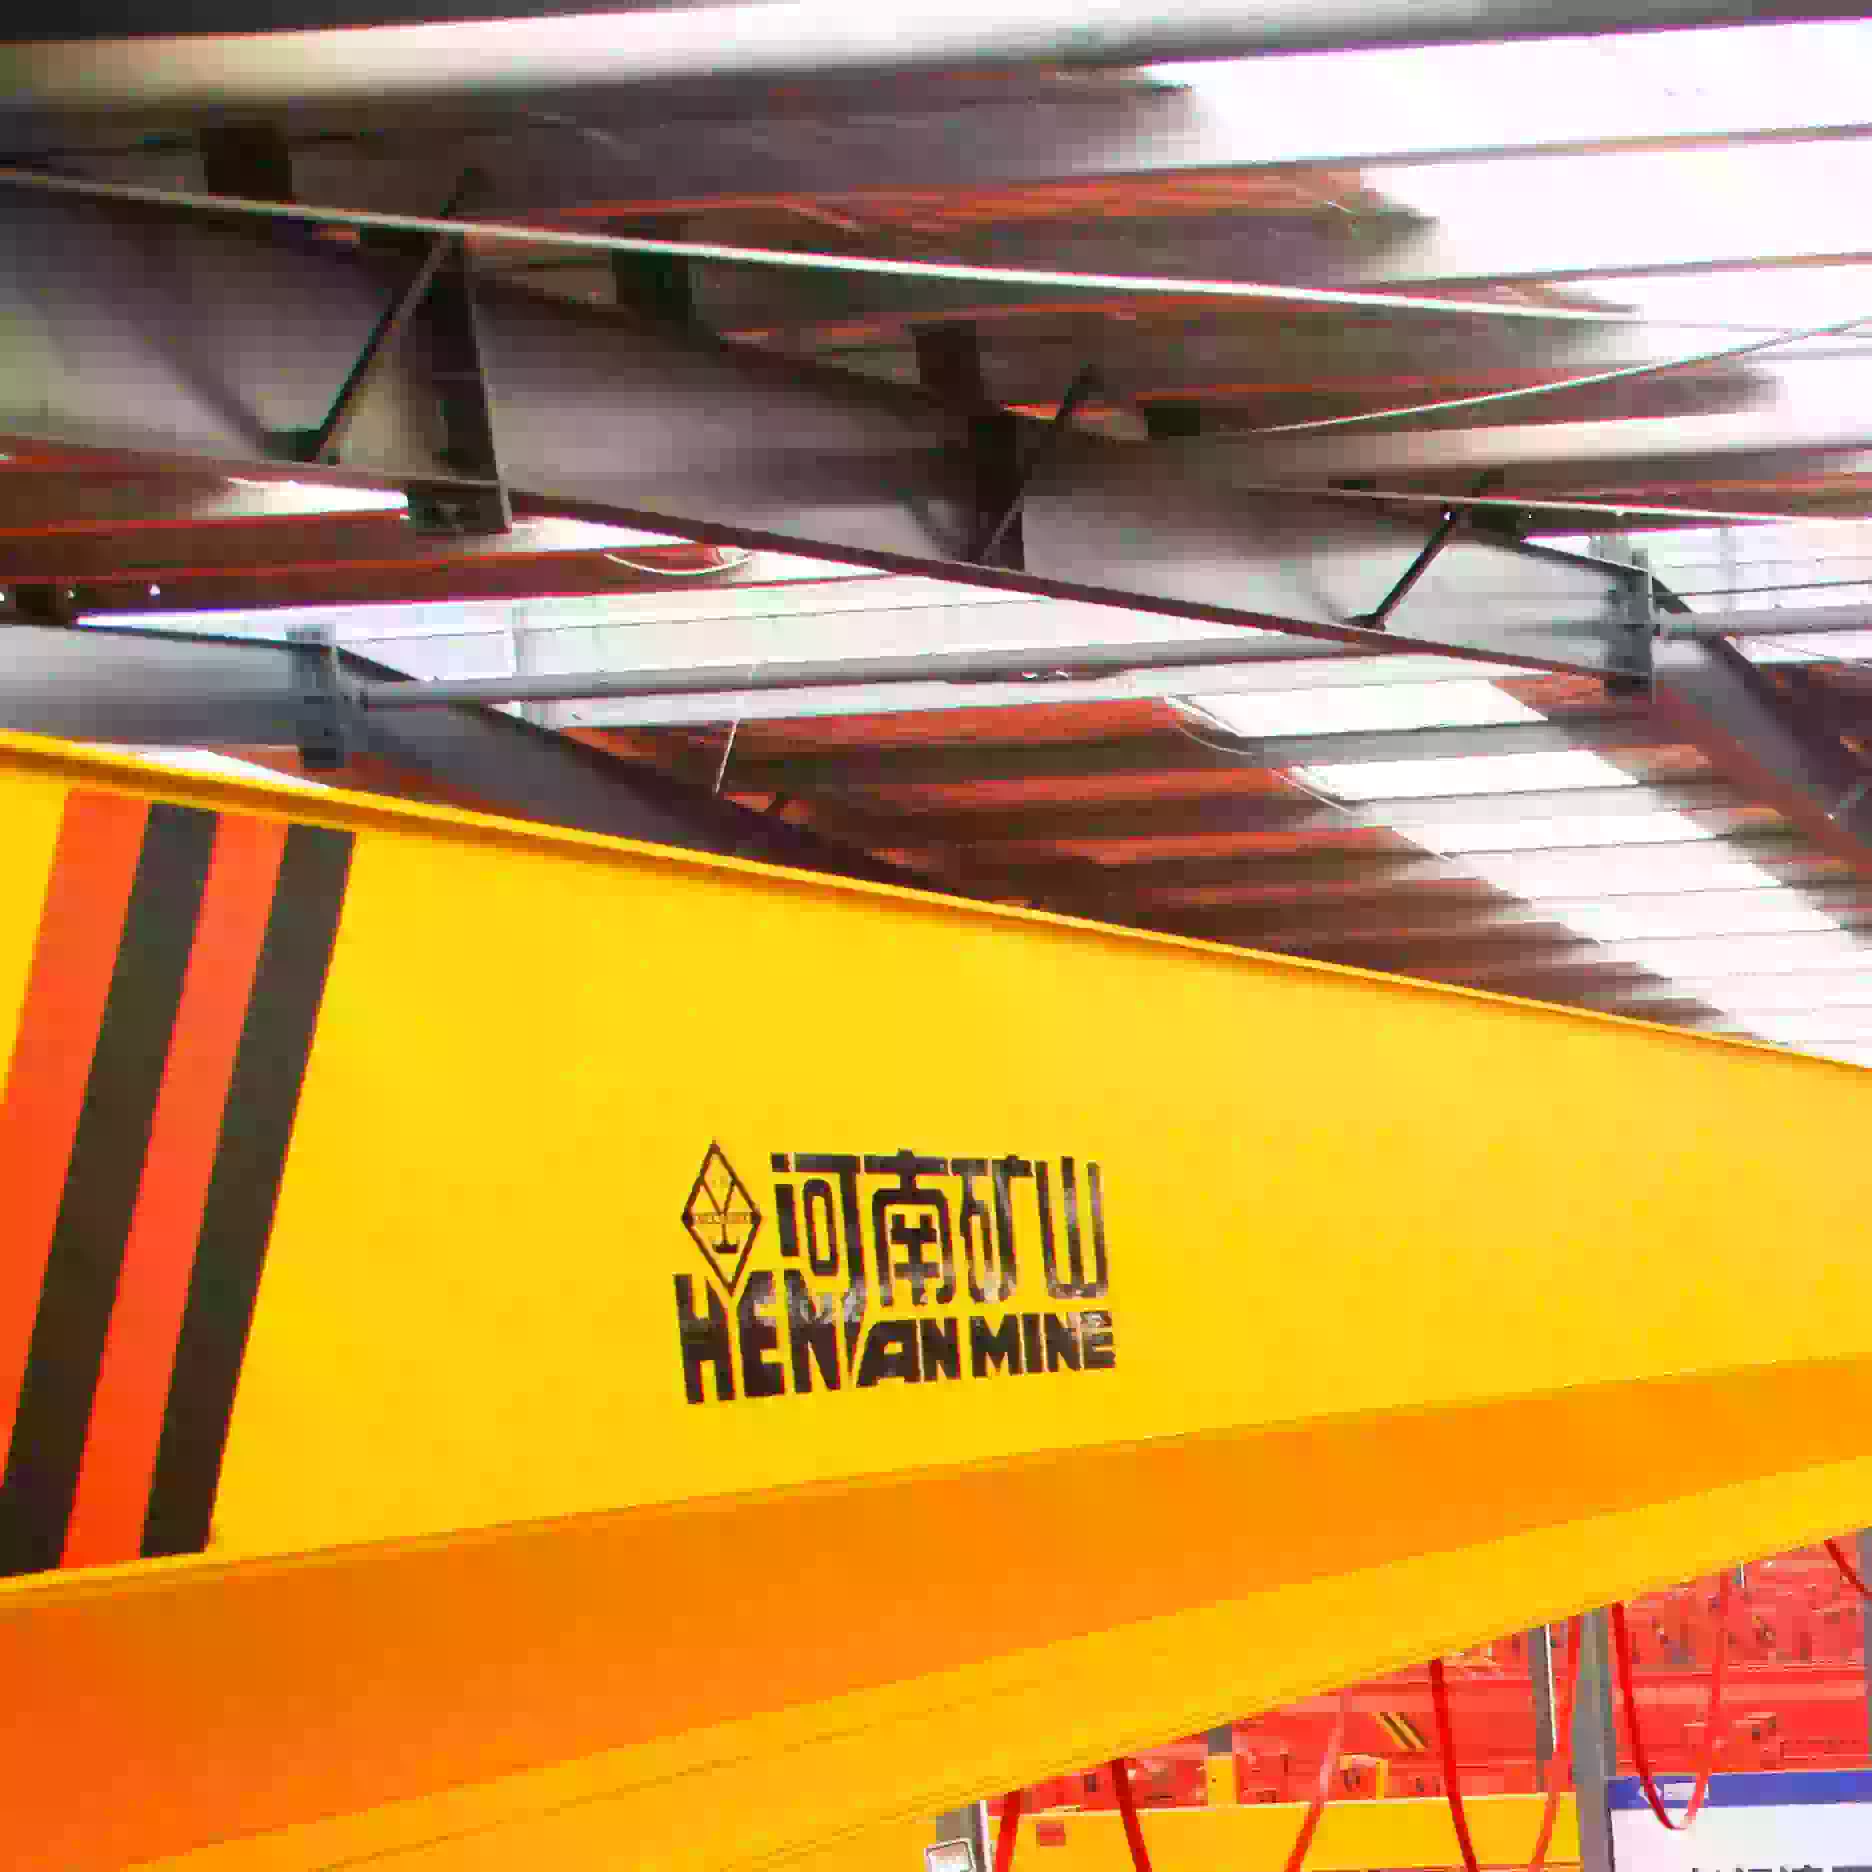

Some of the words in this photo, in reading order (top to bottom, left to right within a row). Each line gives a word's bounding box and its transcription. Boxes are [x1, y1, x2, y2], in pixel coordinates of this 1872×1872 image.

[770, 1149, 1109, 1306] 河南矿山
[673, 1269, 962, 1405] HENAN
[970, 1309, 1117, 1379] MINE
